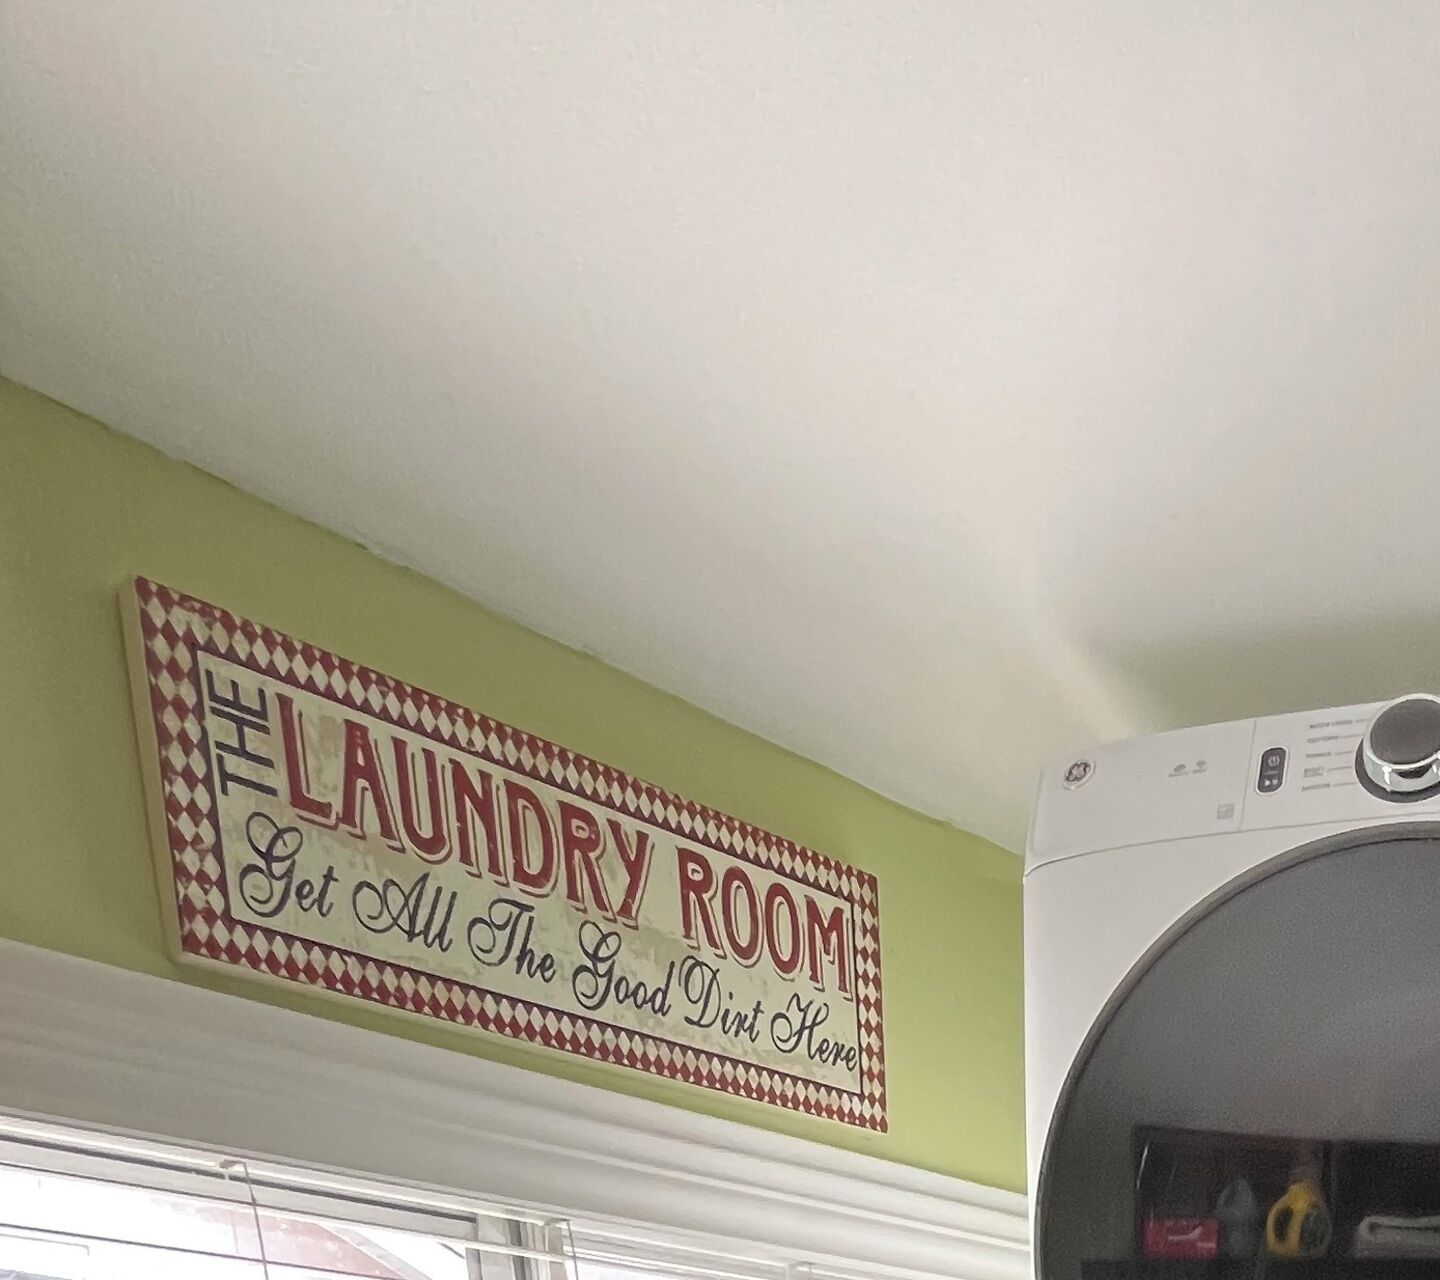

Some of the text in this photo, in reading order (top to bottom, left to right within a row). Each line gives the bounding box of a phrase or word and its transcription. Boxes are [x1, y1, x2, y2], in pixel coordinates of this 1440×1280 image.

[207, 669, 278, 796] THE
[274, 691, 853, 1001] LAUNDRY ROOM
[239, 811, 859, 1074] Get All The Good Dirt Here
